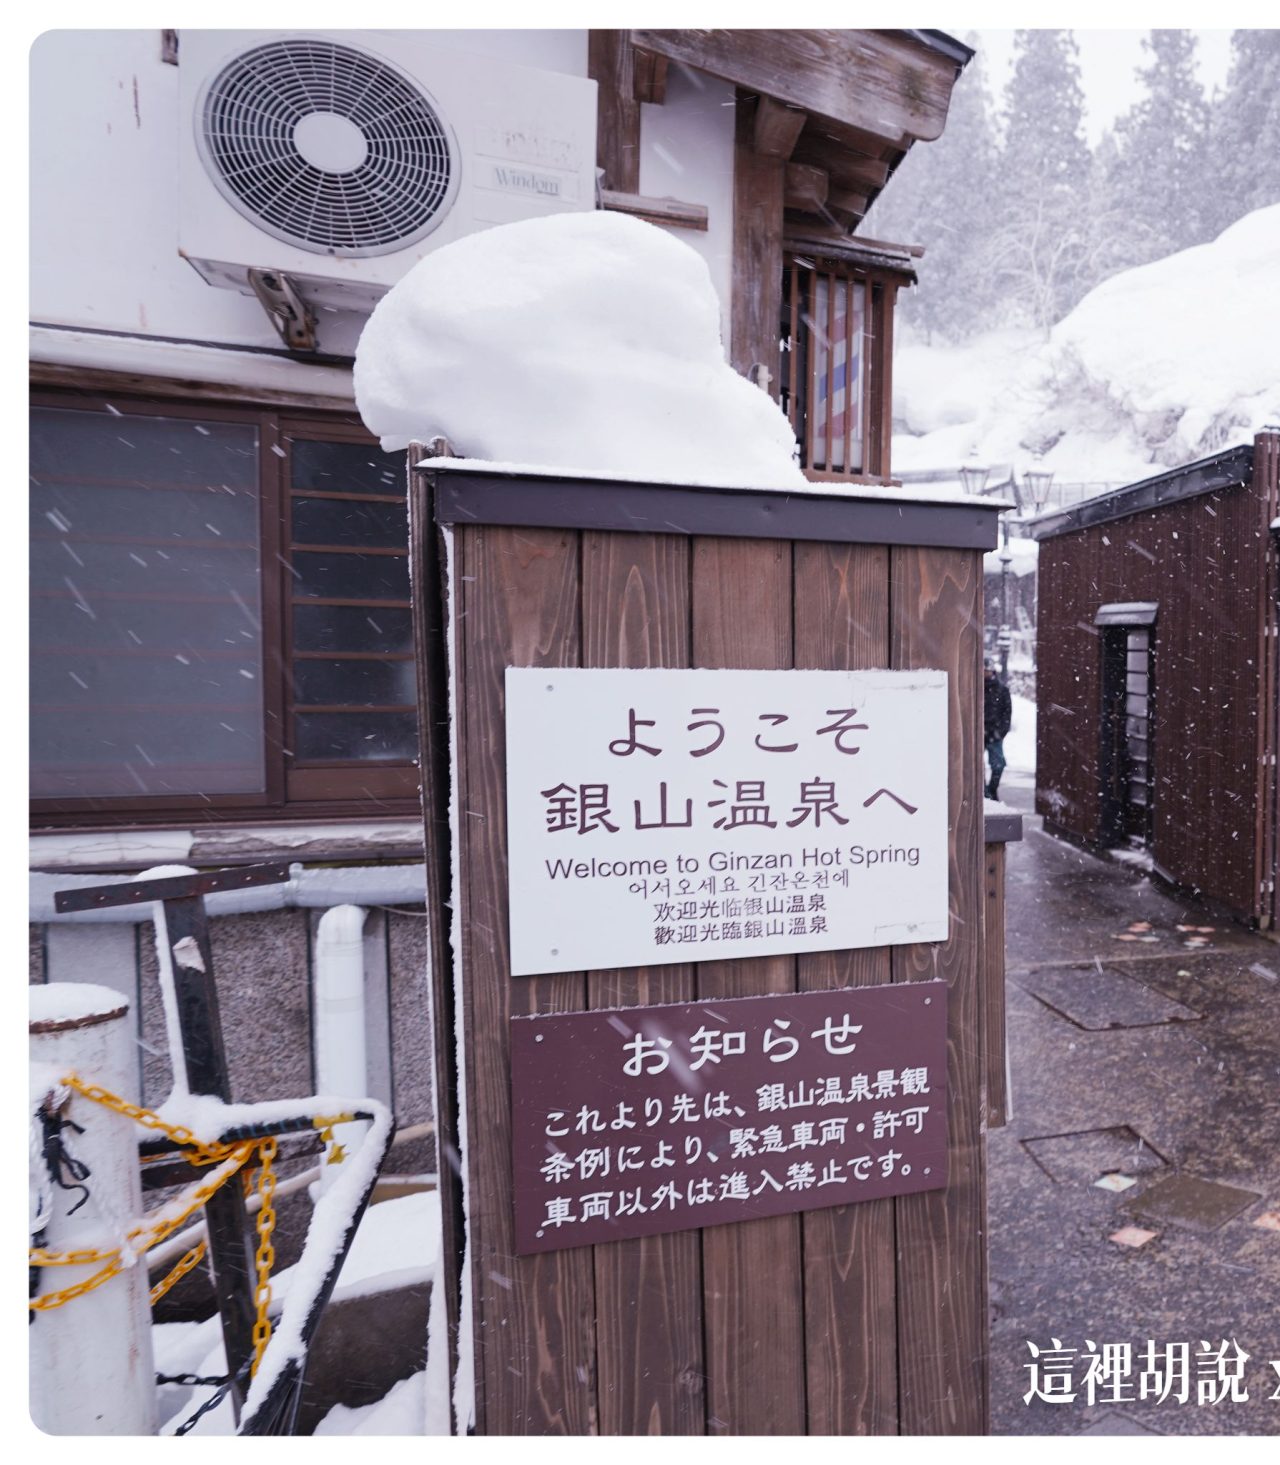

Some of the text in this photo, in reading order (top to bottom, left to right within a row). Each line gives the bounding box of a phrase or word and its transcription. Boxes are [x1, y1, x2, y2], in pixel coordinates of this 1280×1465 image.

[495, 167, 559, 194] Windom
[608, 707, 870, 758] ようこそ
[540, 776, 918, 835] 銀山温泉へ
[545, 845, 920, 880] Welcome to Ginzan Hot Spring
[629, 869, 849, 900] 어서오세요 긴잔온천에
[652, 893, 828, 923] 欢迎光临银山温泉
[653, 915, 829, 946] 歡迎光臨銀山溫泉
[622, 1014, 863, 1077] お知らせ
[544, 1066, 930, 1138] これより先は、銀山温泉景観
[540, 1106, 930, 1184] 条例により、緊急車両・許可
[541, 1149, 912, 1228] 車両以外は進入禁止です。
